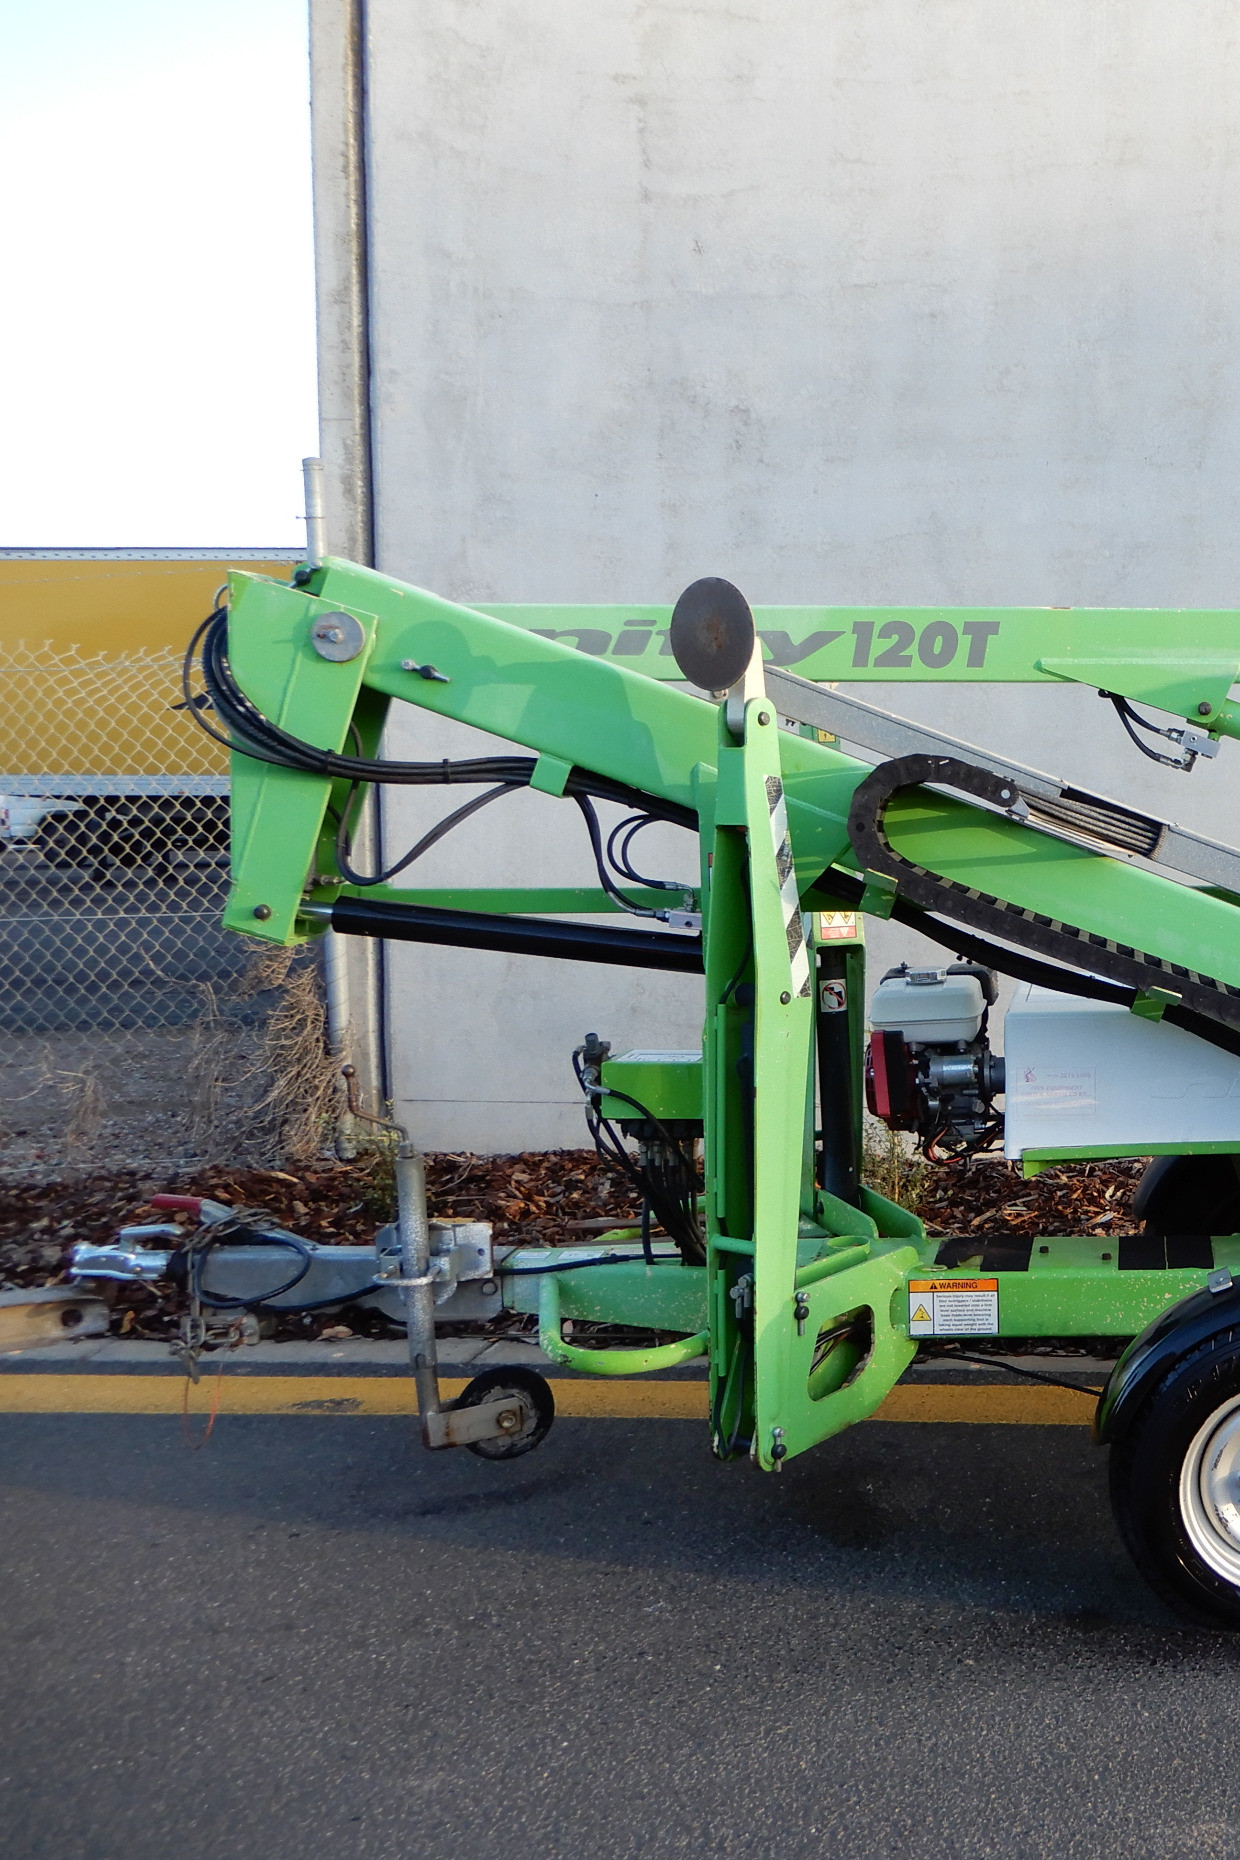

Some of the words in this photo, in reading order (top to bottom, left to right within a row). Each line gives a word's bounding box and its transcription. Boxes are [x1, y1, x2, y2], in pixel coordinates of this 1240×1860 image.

[529, 619, 846, 667] niy
[851, 620, 1001, 669] 120T
[939, 1281, 978, 1289] WARNING
